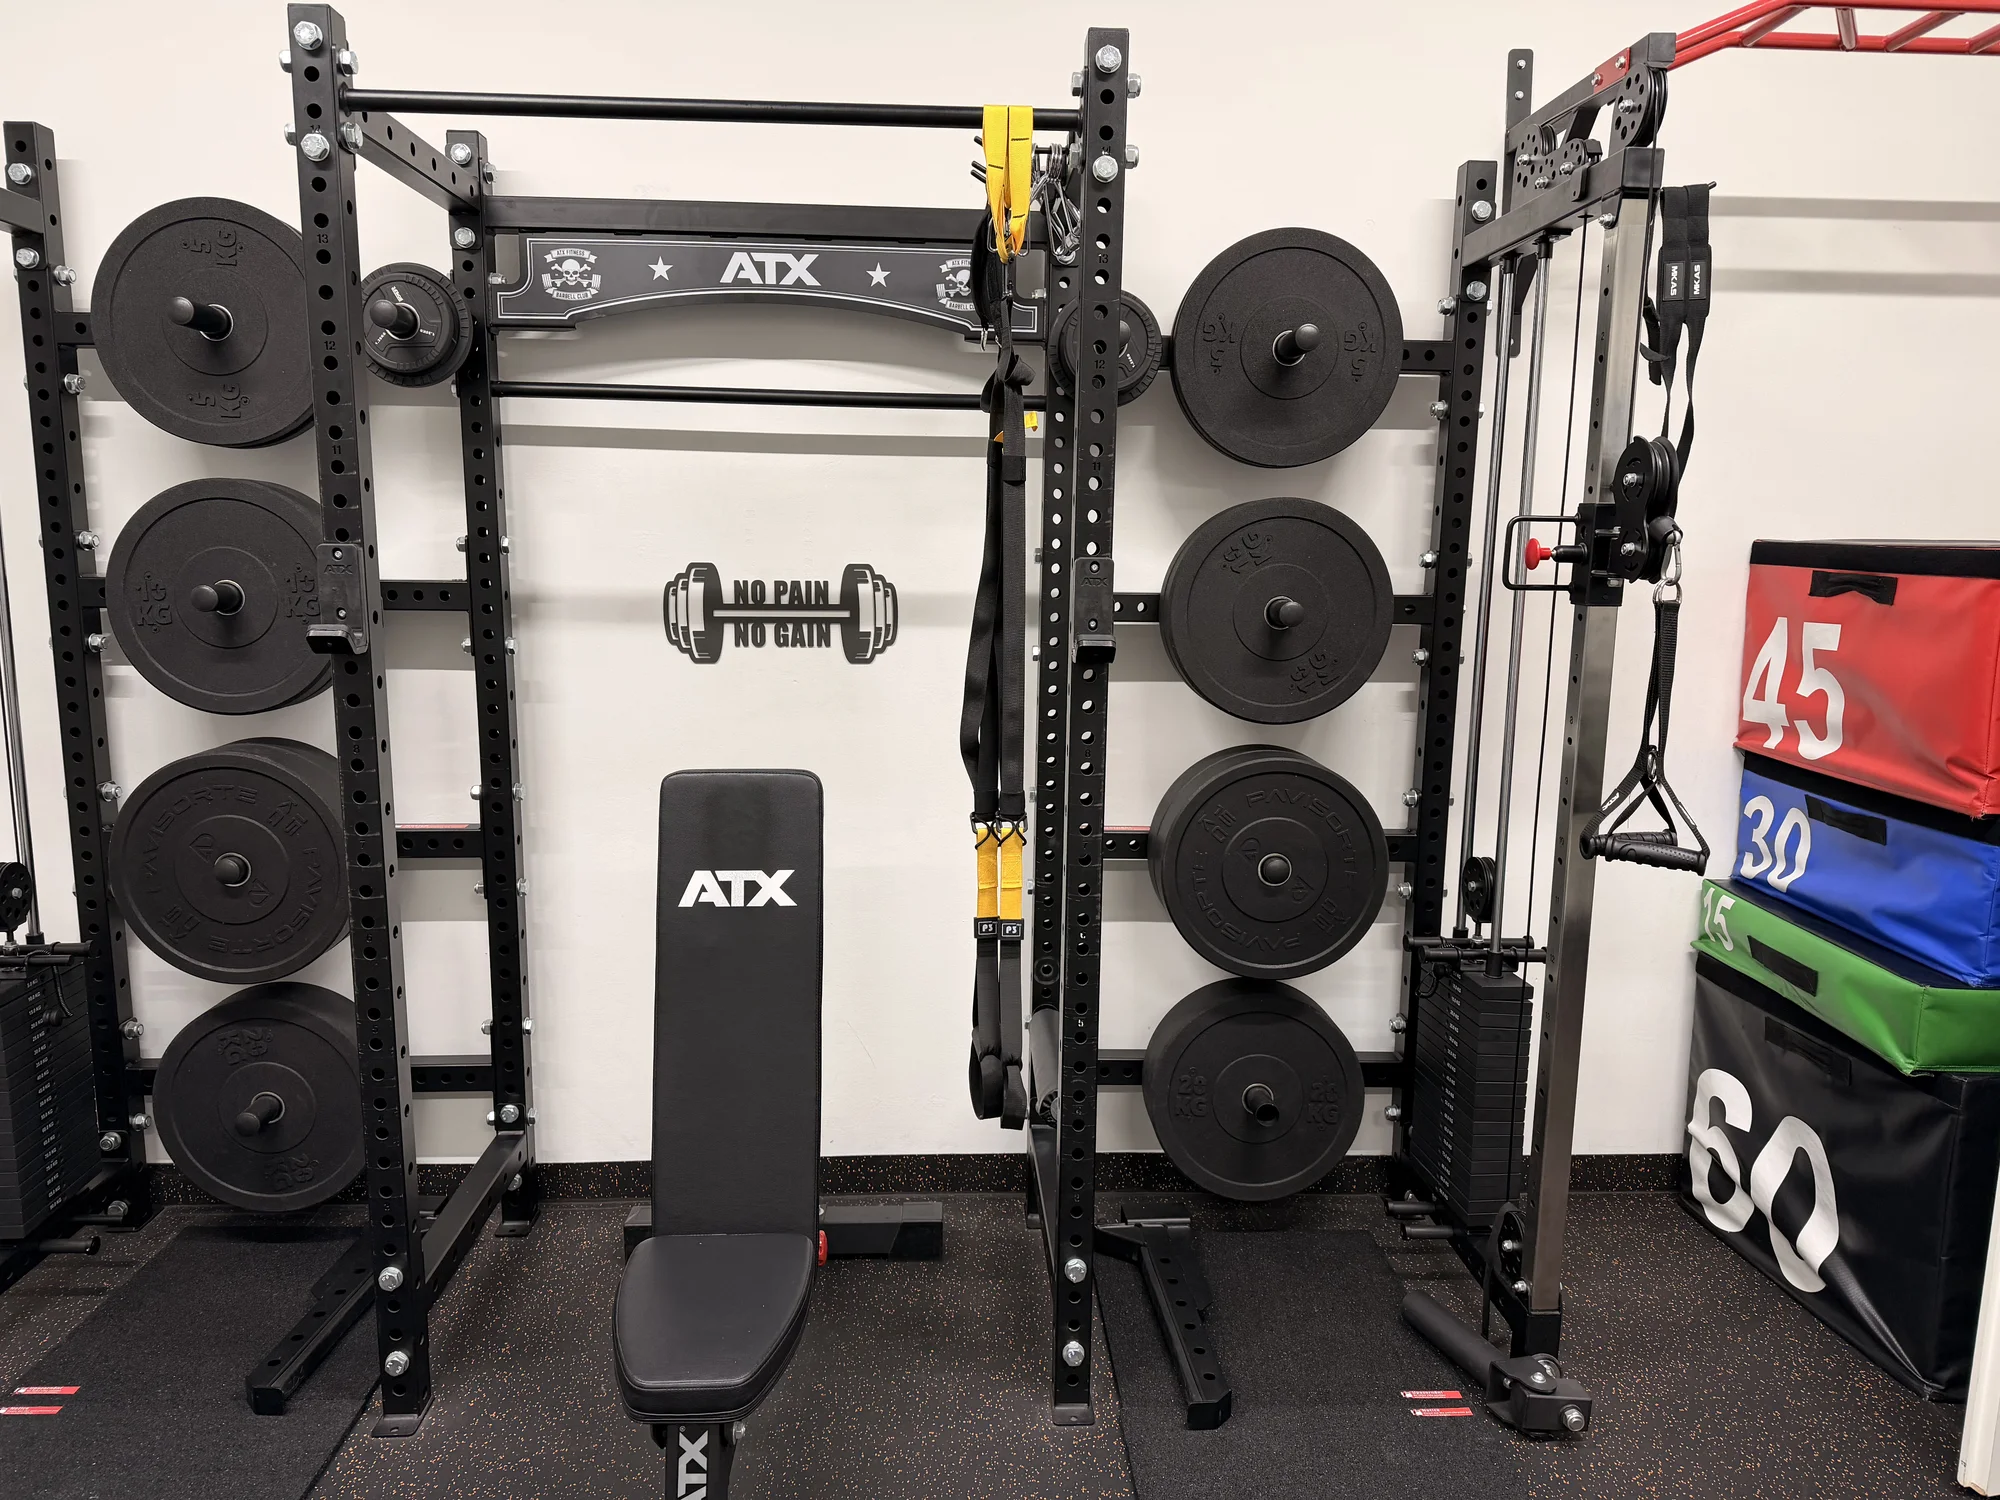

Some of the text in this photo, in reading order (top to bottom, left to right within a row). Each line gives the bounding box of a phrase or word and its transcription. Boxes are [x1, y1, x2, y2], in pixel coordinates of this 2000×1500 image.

[216, 228, 239, 267] KG
[317, 234, 328, 244] 13
[720, 252, 821, 286] ATX
[1098, 254, 1109, 263] 13
[1670, 265, 1678, 296] MKAS
[1693, 264, 1701, 295] MKAS
[324, 341, 336, 350] 12
[1094, 360, 1106, 369] 12
[220, 383, 243, 419] KG
[332, 446, 341, 454] 11
[1092, 462, 1101, 470] 11
[325, 564, 353, 575] ATX
[734, 580, 829, 605] NO PAIN
[1081, 577, 1108, 586] ATX
[137, 605, 173, 627] KG
[286, 597, 320, 618] KG
[734, 622, 831, 648] NO GAIN
[1742, 616, 1846, 761] 45
[1742, 795, 1812, 893] 30
[678, 870, 797, 907] ATX
[1701, 886, 1734, 952] 15
[1176, 1096, 1208, 1118] KG
[1307, 1103, 1341, 1125] KG
[1687, 1068, 1840, 1293] 60
